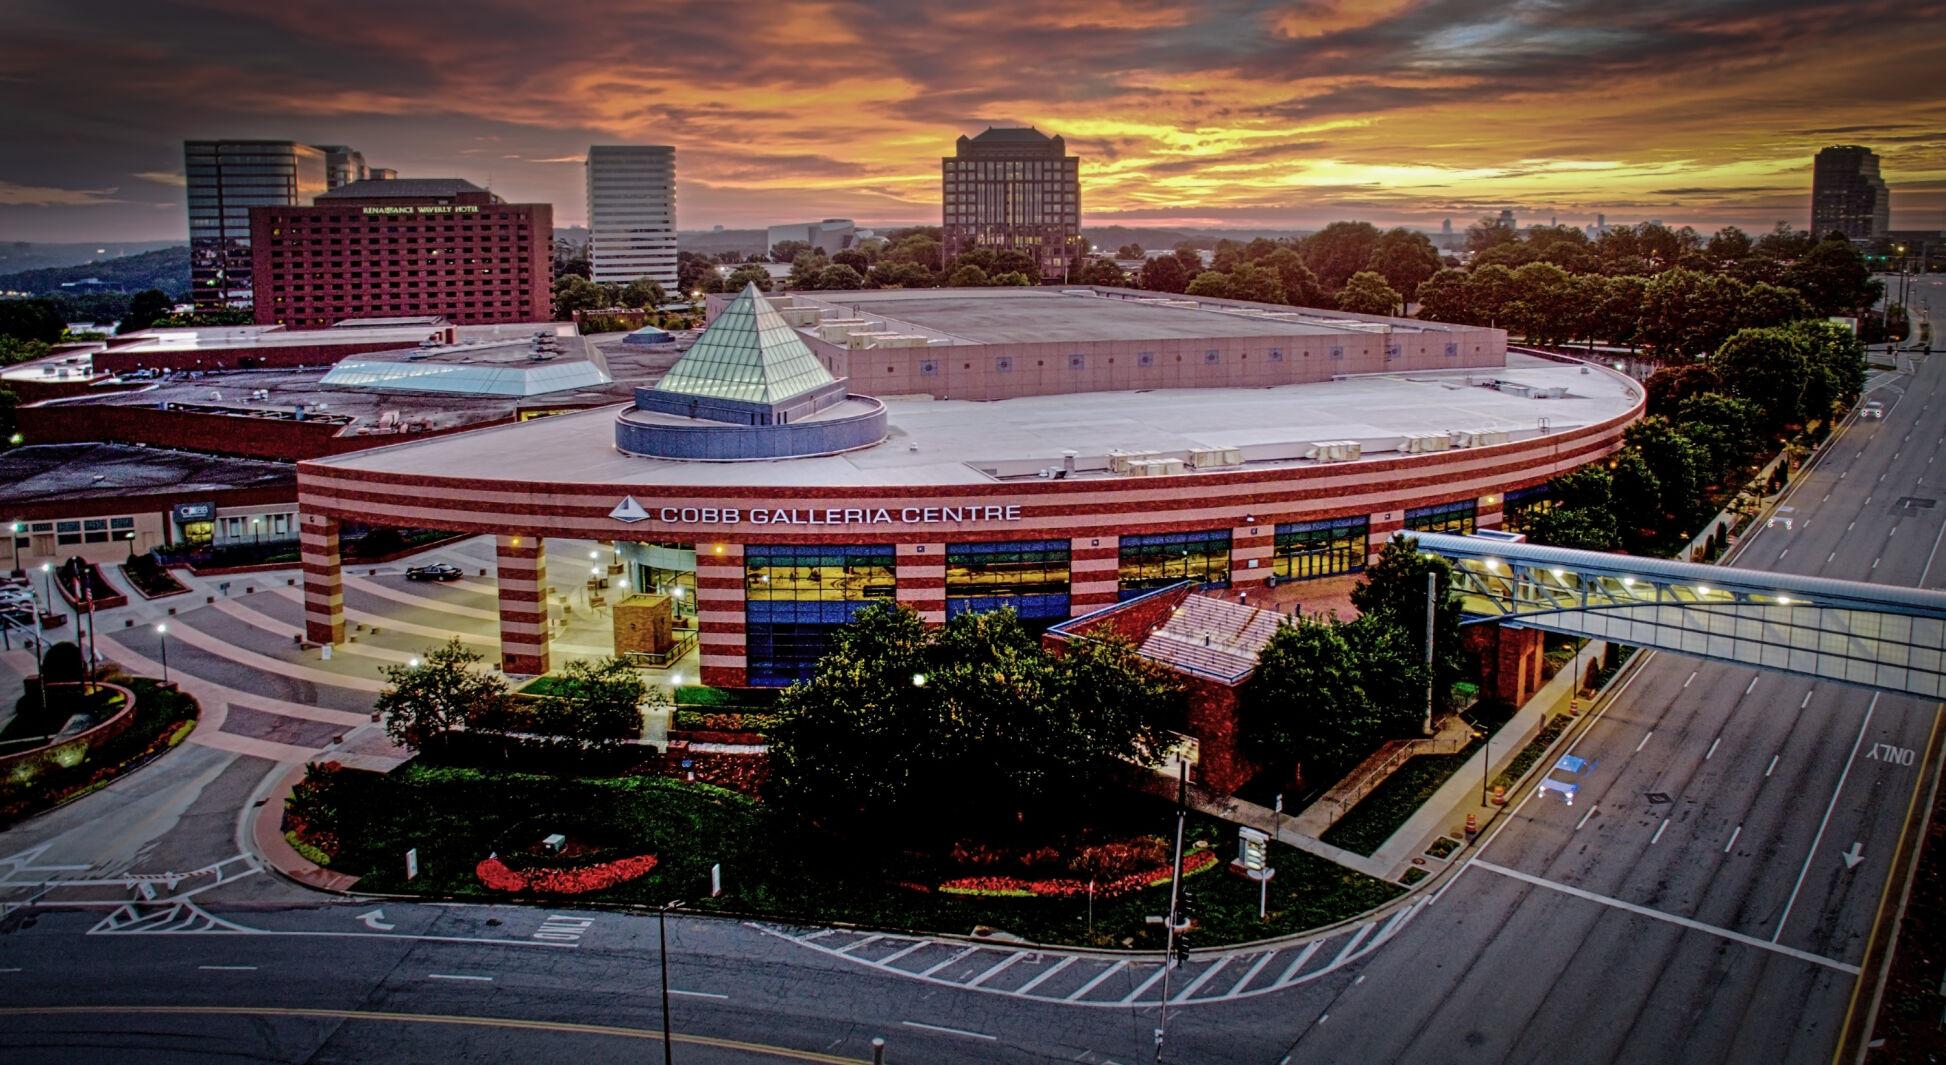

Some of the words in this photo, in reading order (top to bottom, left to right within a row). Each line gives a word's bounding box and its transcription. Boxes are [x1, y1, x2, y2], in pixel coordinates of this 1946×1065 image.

[660, 507, 740, 524] COBB
[750, 508, 892, 525] GALLERIA
[901, 505, 1021, 524] CENTRE
[1865, 742, 1916, 767] ONLY
[533, 914, 595, 941] ONLY
